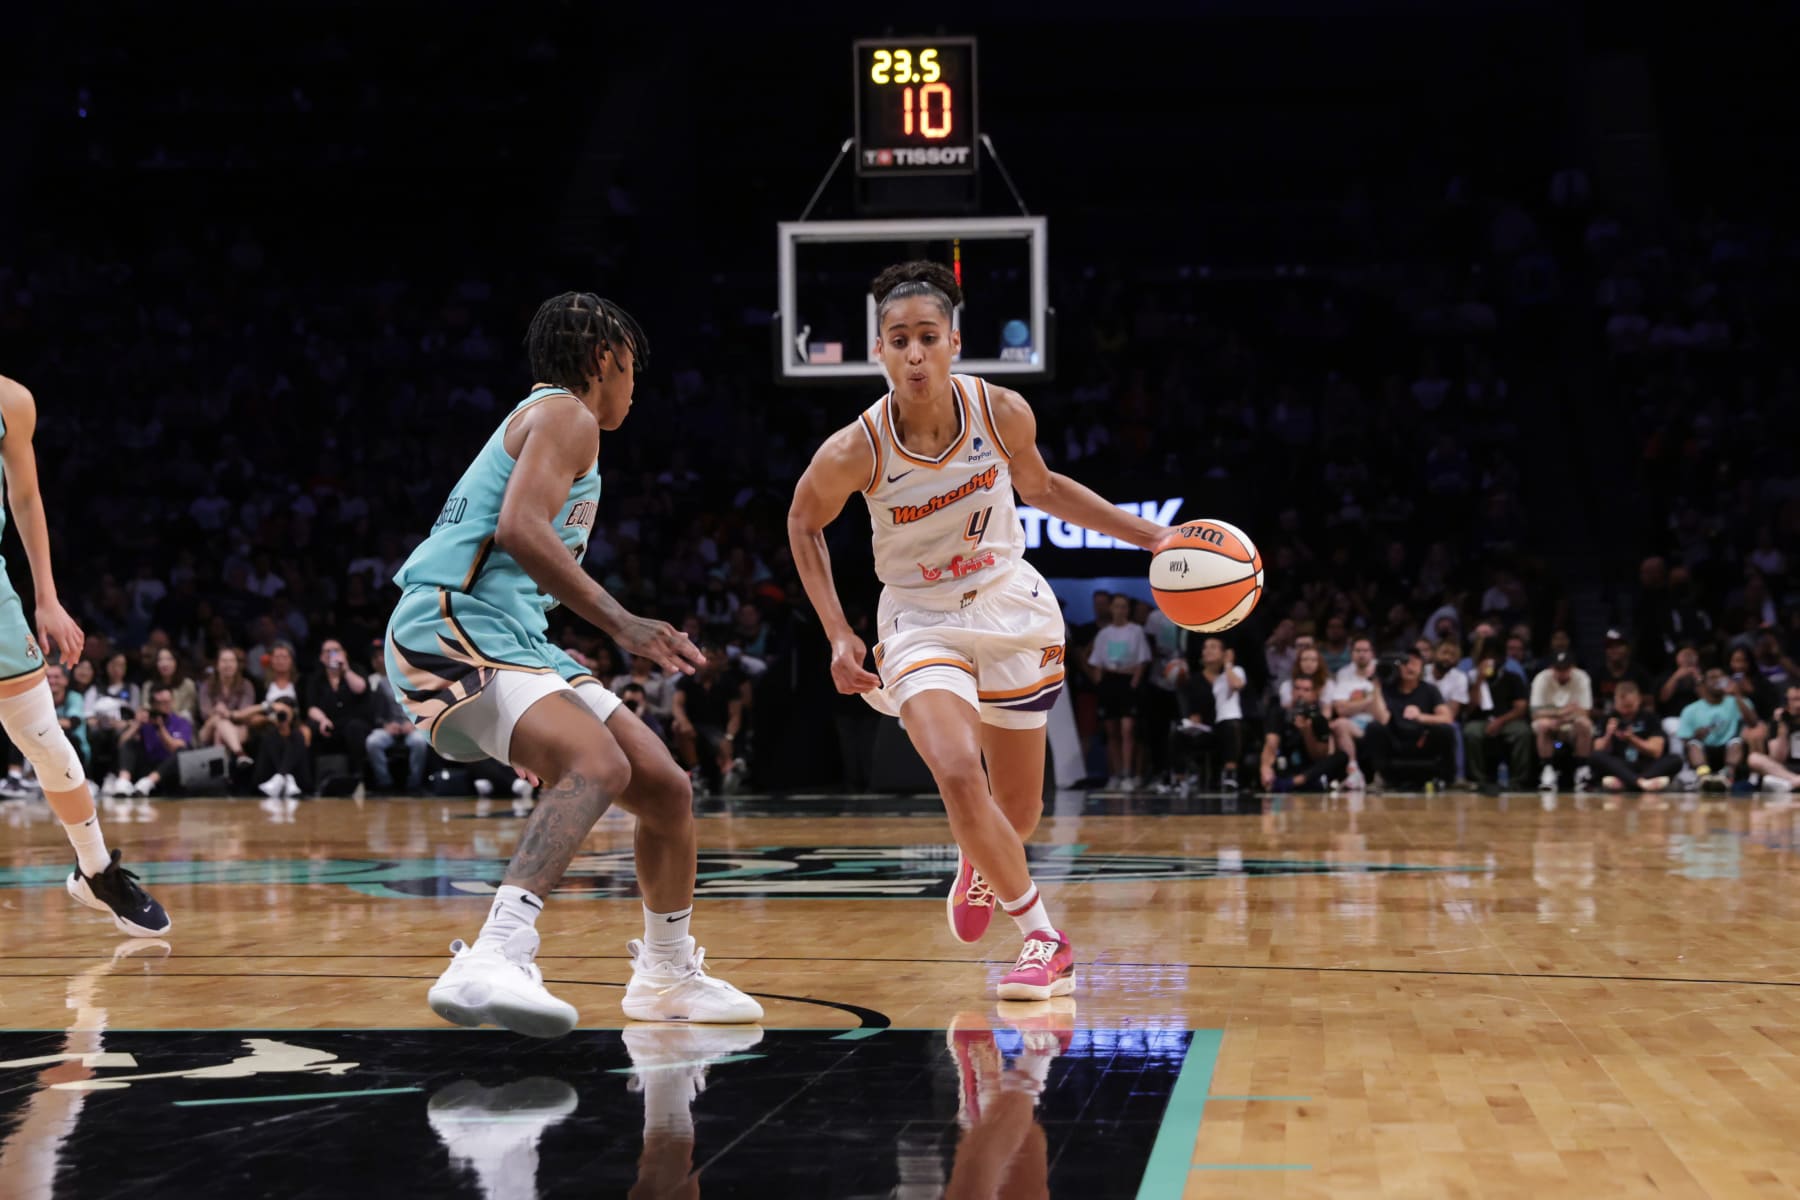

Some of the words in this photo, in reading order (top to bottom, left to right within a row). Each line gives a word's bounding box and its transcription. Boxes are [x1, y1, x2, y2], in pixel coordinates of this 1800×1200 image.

[871, 48, 941, 84] 23.5
[903, 82, 952, 138] 10
[893, 146, 970, 165] TISSOT
[968, 449, 992, 462] PayPal
[887, 464, 999, 526] Mercury
[963, 506, 993, 550] 4
